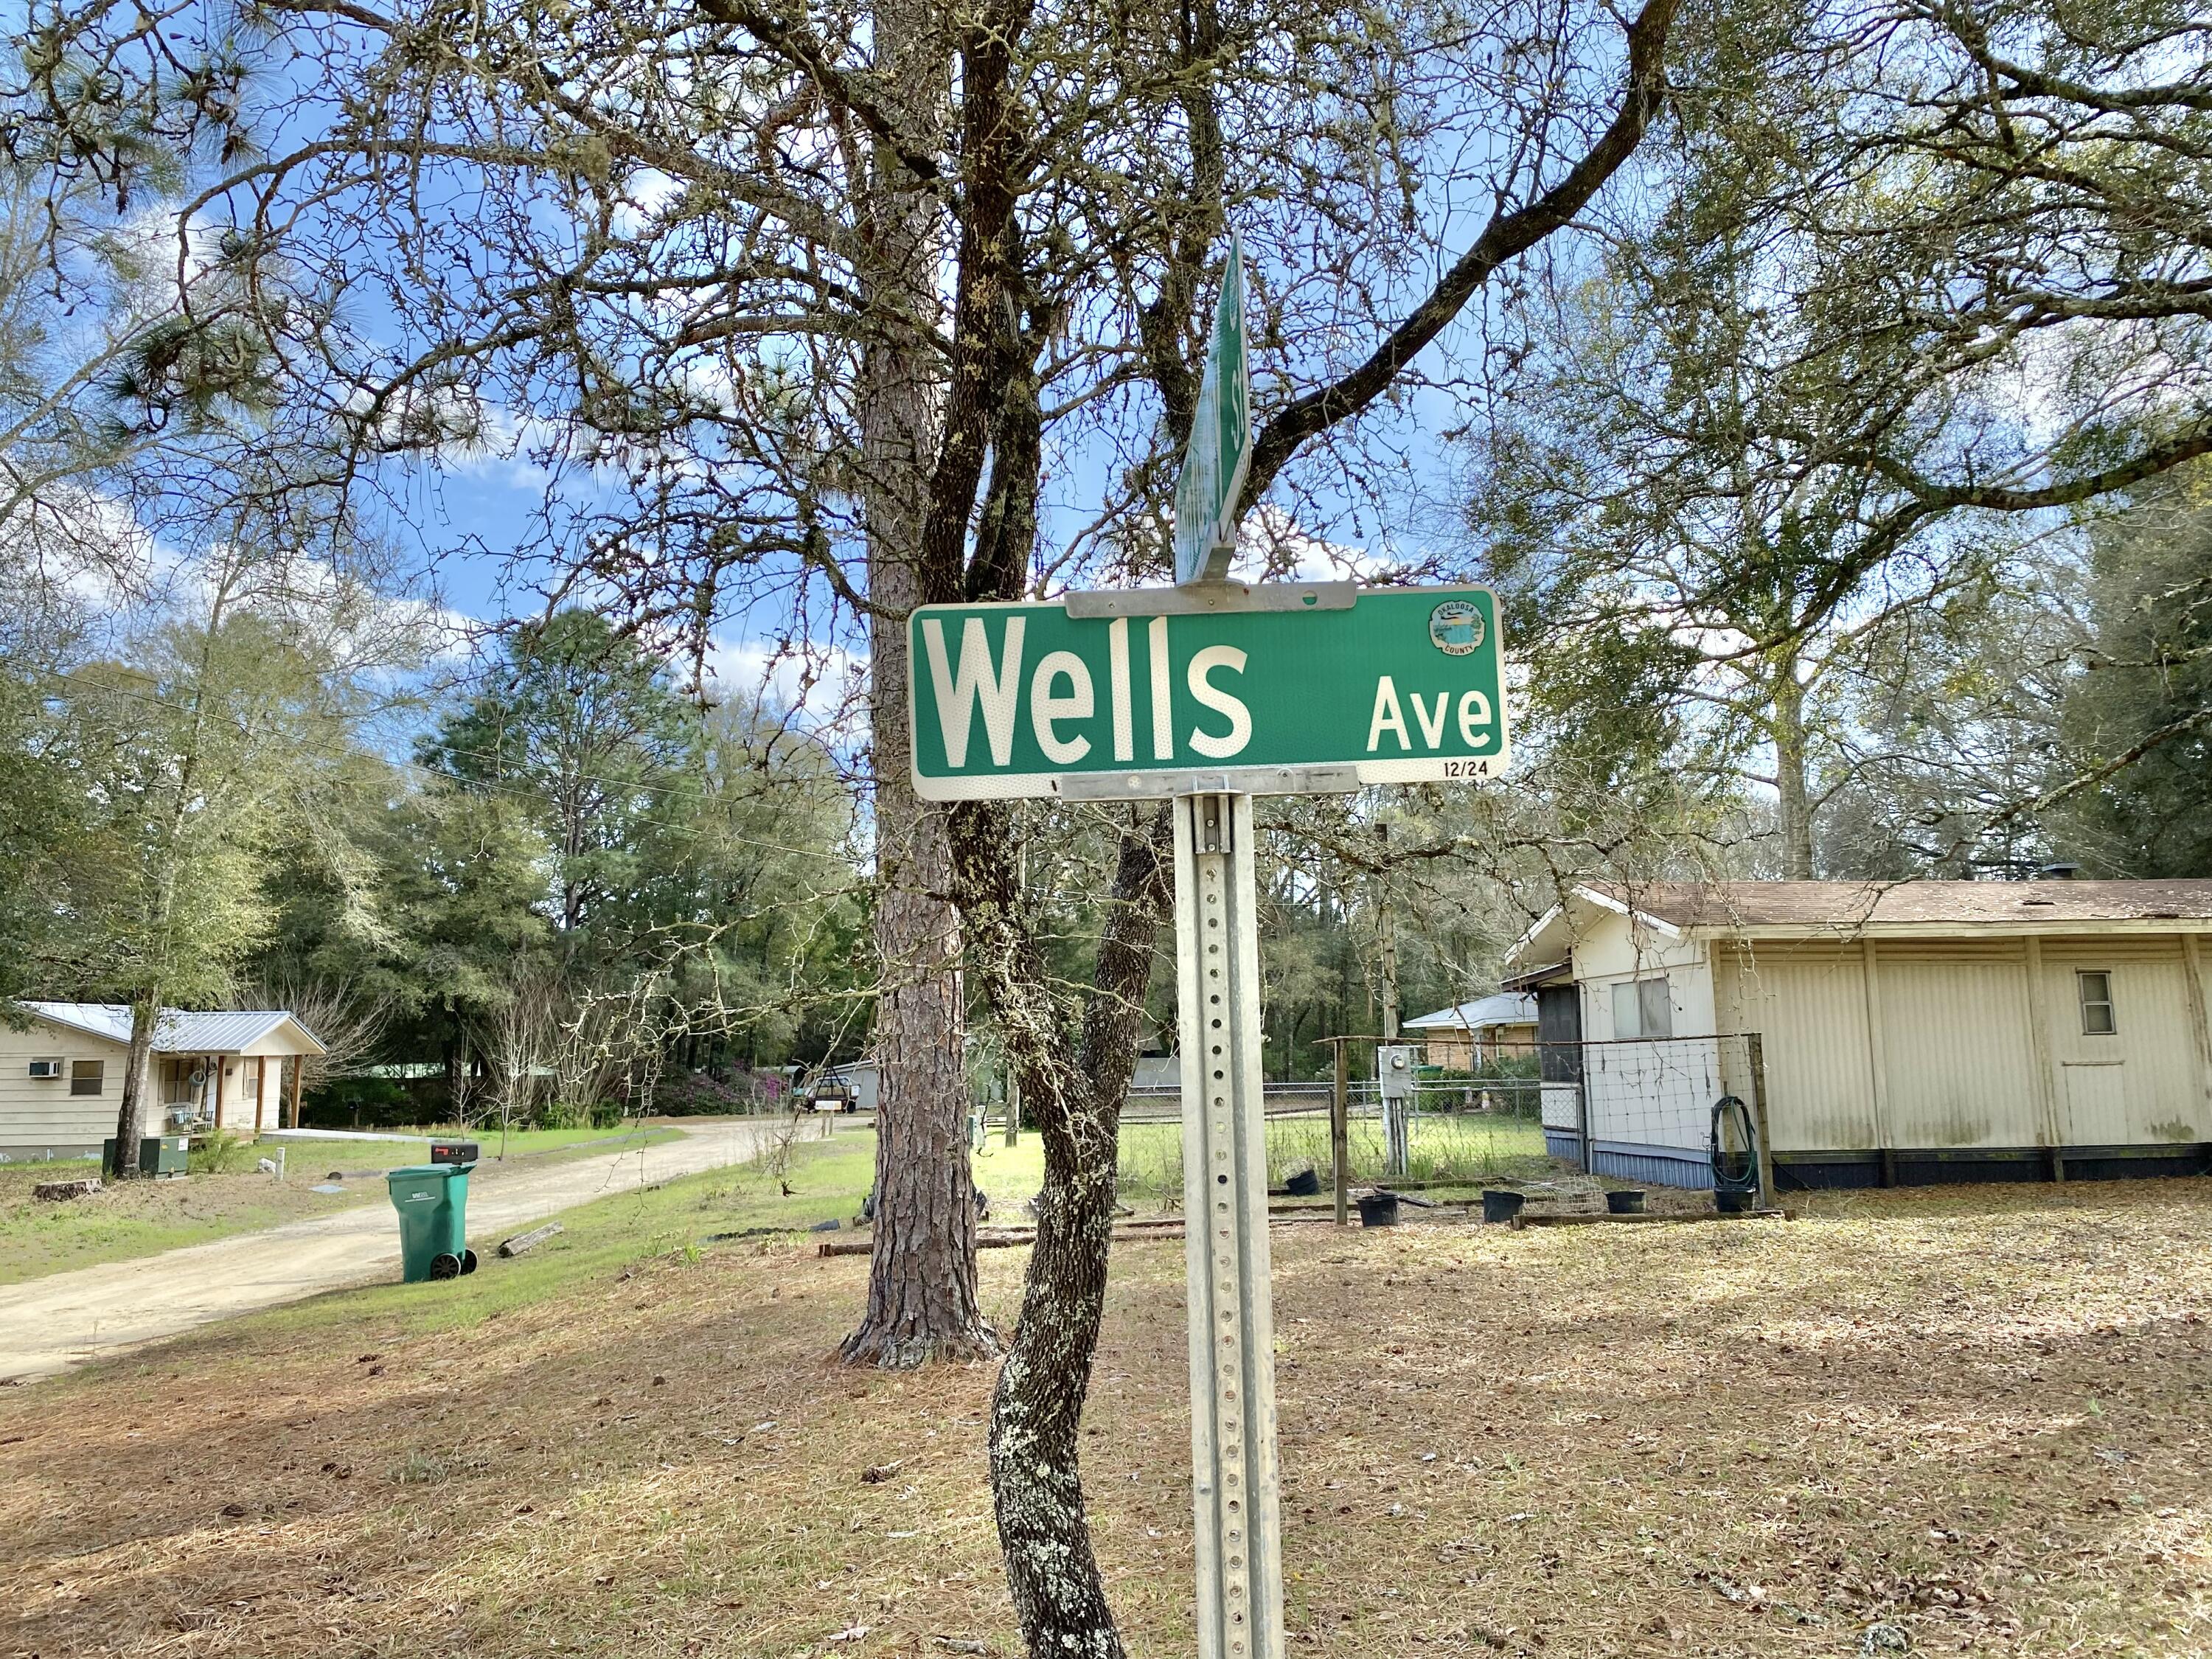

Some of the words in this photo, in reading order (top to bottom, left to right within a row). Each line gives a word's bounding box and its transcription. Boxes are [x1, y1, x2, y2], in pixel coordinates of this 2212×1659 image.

[1438, 603, 1474, 616] OKALOOSA
[1445, 644, 1473, 654] COUNTY
[921, 616, 1252, 768] Wells
[1366, 675, 1492, 751] Ave
[1444, 761, 1487, 776] 12/24
